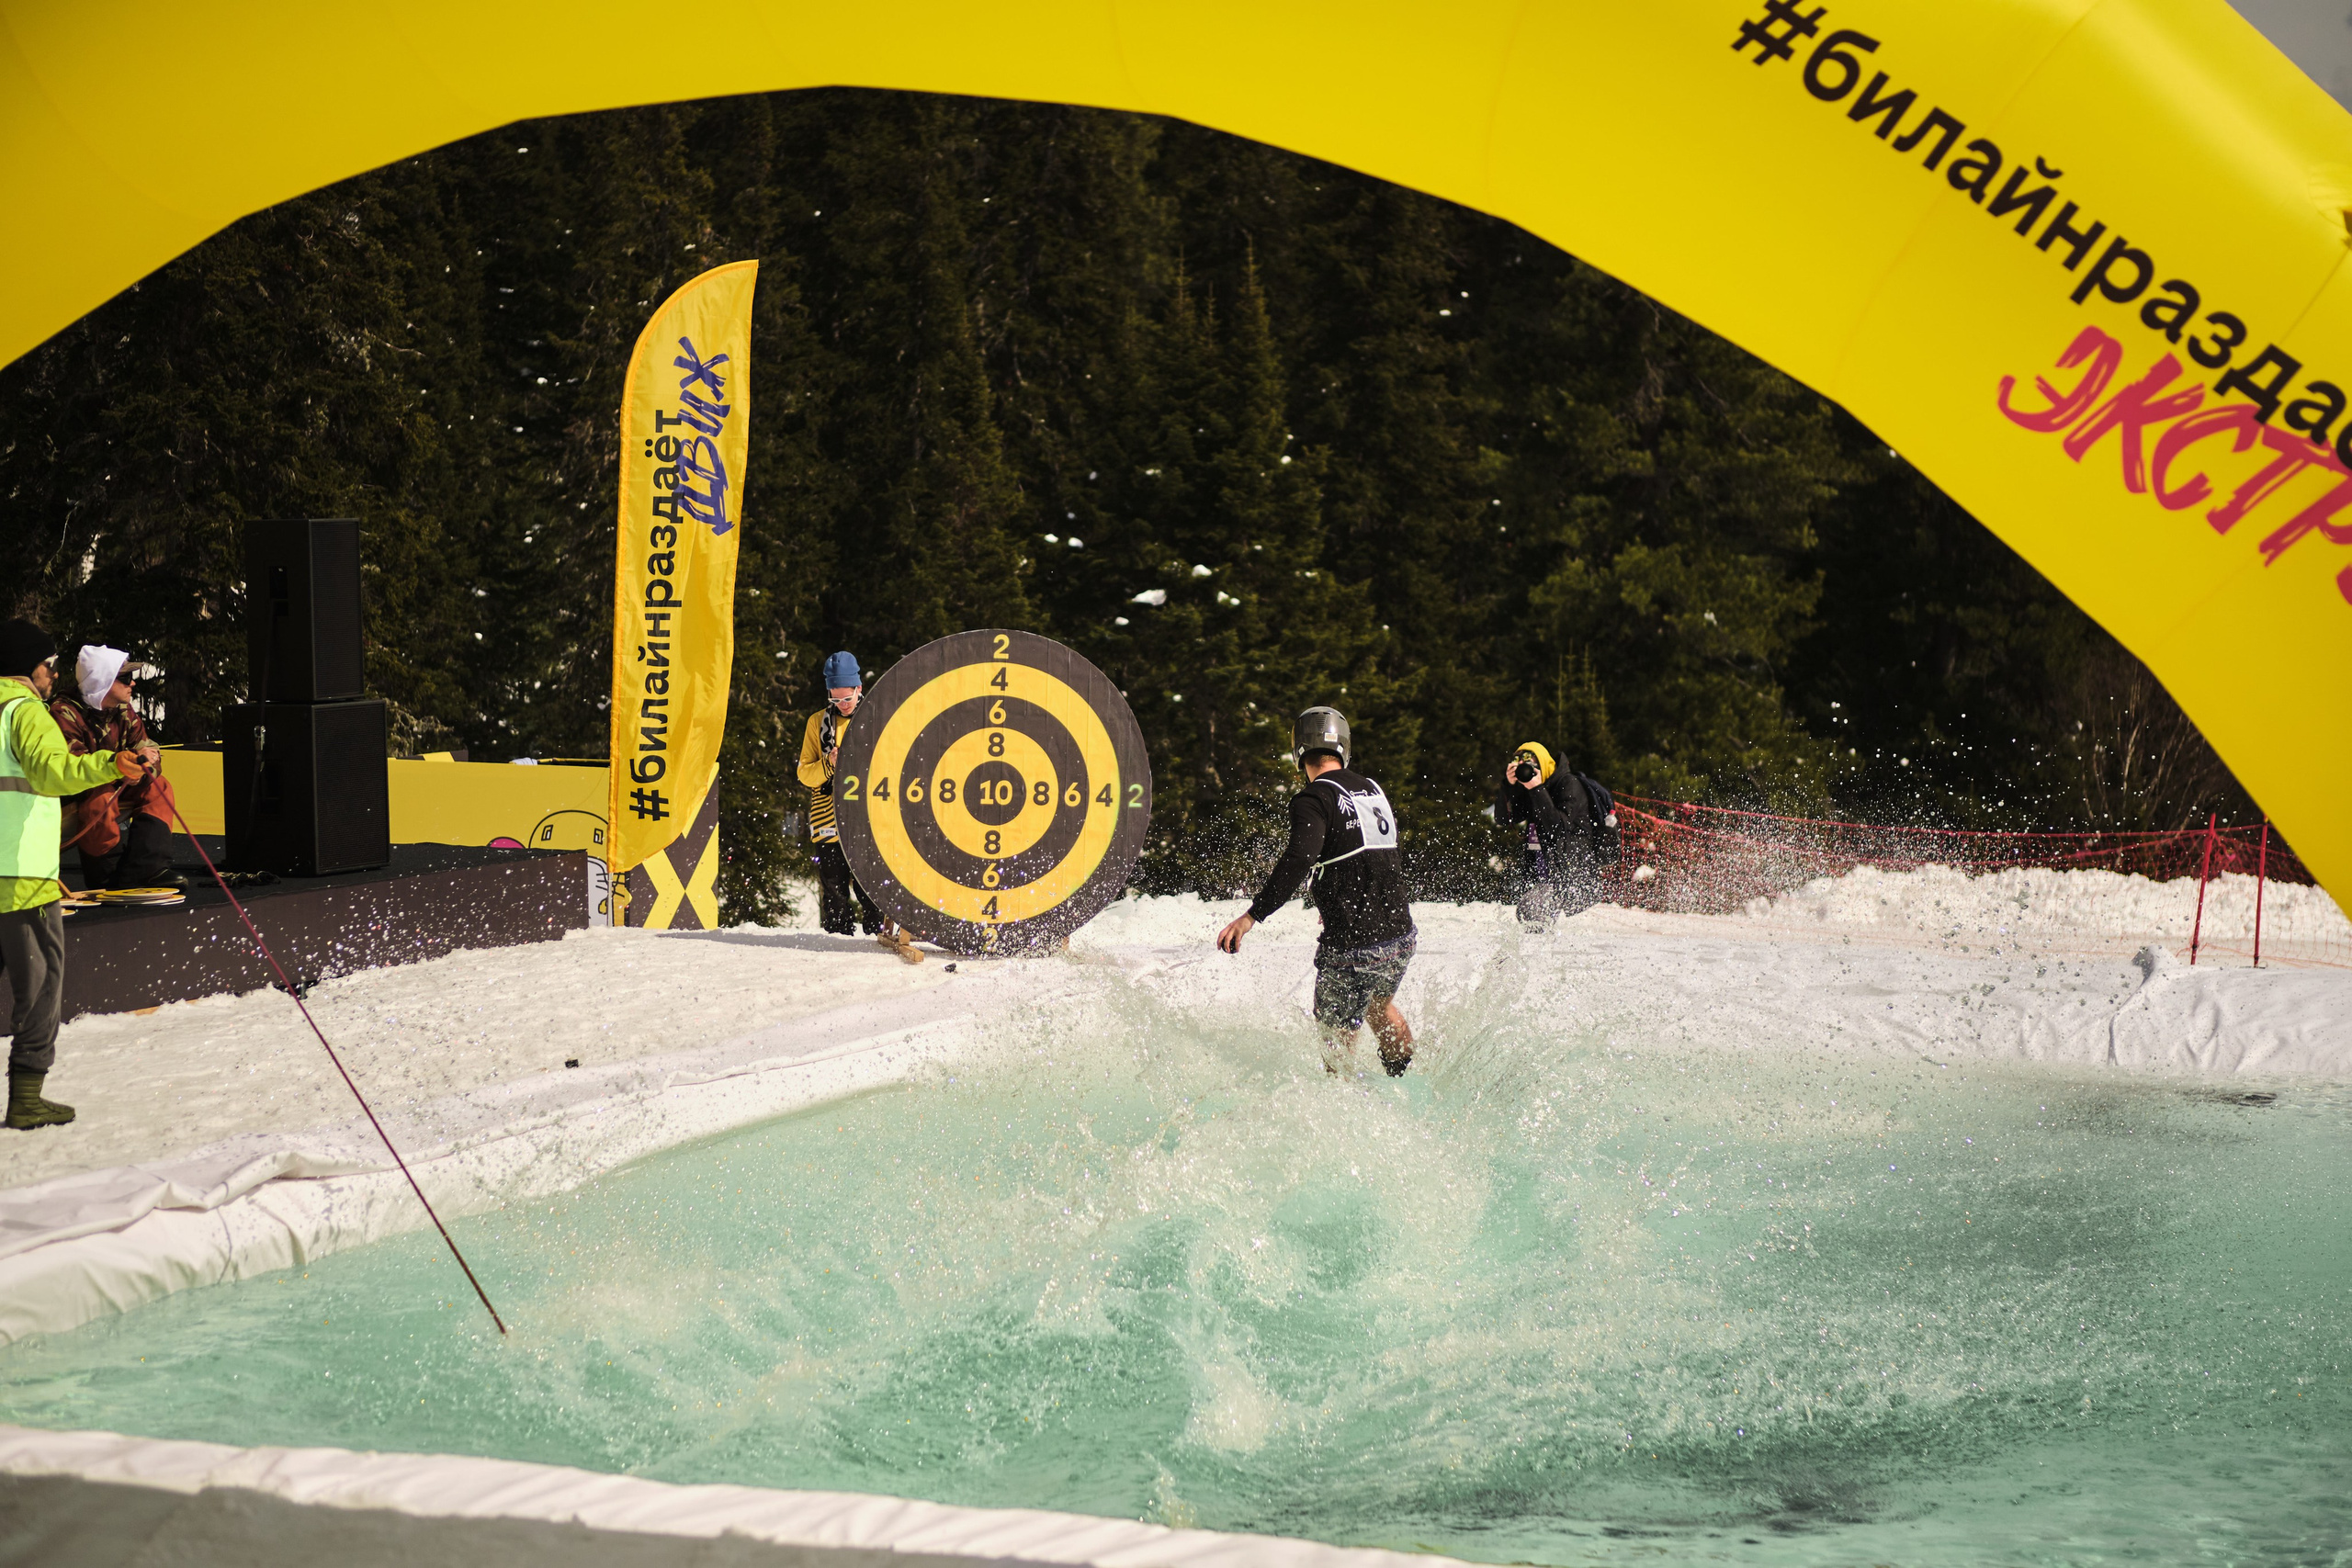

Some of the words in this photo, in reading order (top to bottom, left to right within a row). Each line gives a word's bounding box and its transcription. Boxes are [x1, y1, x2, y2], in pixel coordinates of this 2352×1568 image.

[1731, 0, 2352, 469] #билайнразда
[673, 336, 734, 536] ДВИЖ
[1997, 325, 2352, 606] ЭКСТР
[629, 410, 685, 821] #билайнраздаёт
[993, 634, 1010, 660] 2
[991, 667, 1008, 691] 4
[989, 700, 1006, 724] 6
[988, 732, 1005, 757] 8
[843, 775, 860, 801] 2
[873, 777, 890, 801] 4
[906, 778, 923, 802] 6
[939, 779, 956, 803] 8
[979, 780, 1013, 806] 10
[1033, 781, 1050, 806] 8
[1064, 783, 1081, 807] 6
[1096, 784, 1113, 807] 4
[1128, 784, 1144, 807] 2
[1346, 818, 1361, 829] БЕРЕ
[984, 830, 1001, 854] 8
[982, 863, 1000, 887] 6
[981, 896, 997, 919] 4
